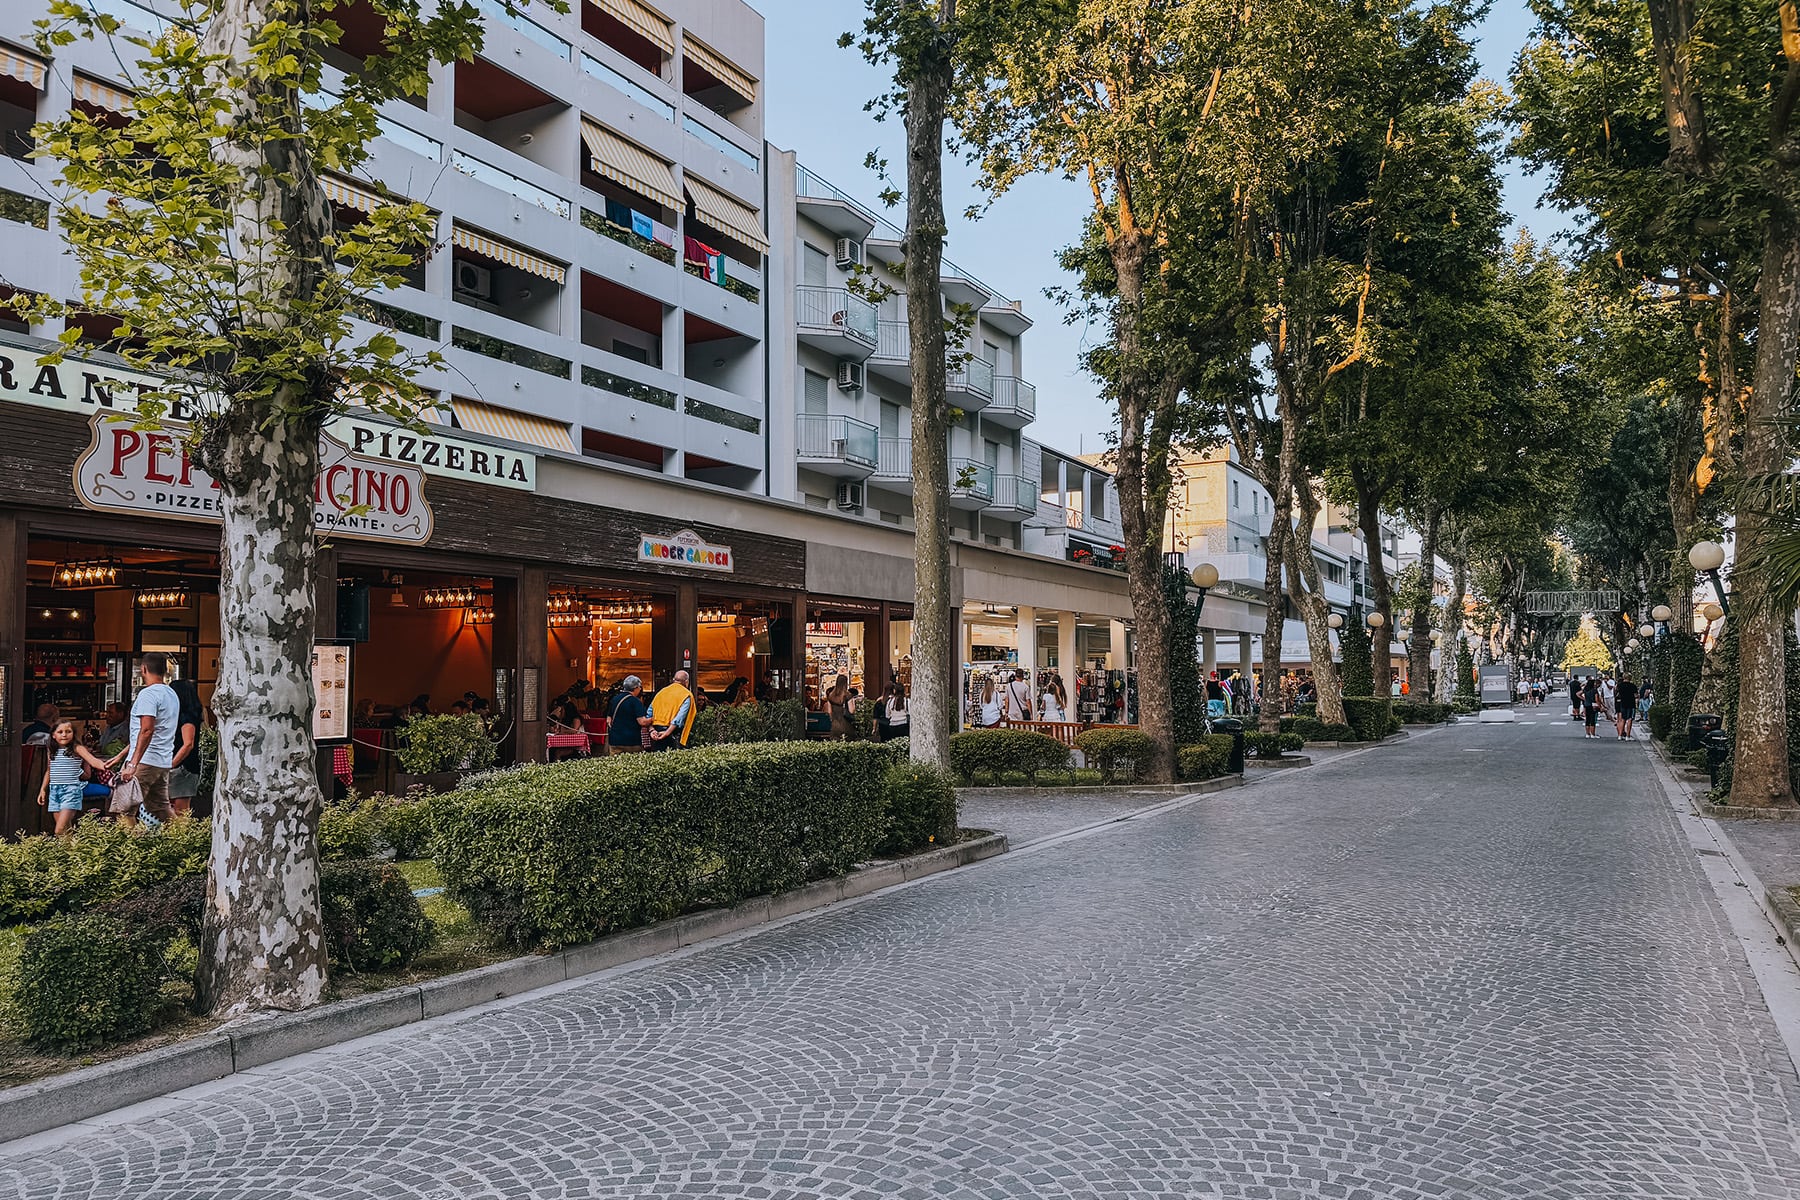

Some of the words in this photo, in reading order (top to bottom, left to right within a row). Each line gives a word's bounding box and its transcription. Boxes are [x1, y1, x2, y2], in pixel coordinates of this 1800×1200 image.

[352, 426, 528, 483] PIZZERIA
[644, 541, 685, 561] KINDER
[686, 548, 728, 566] GARDEN
